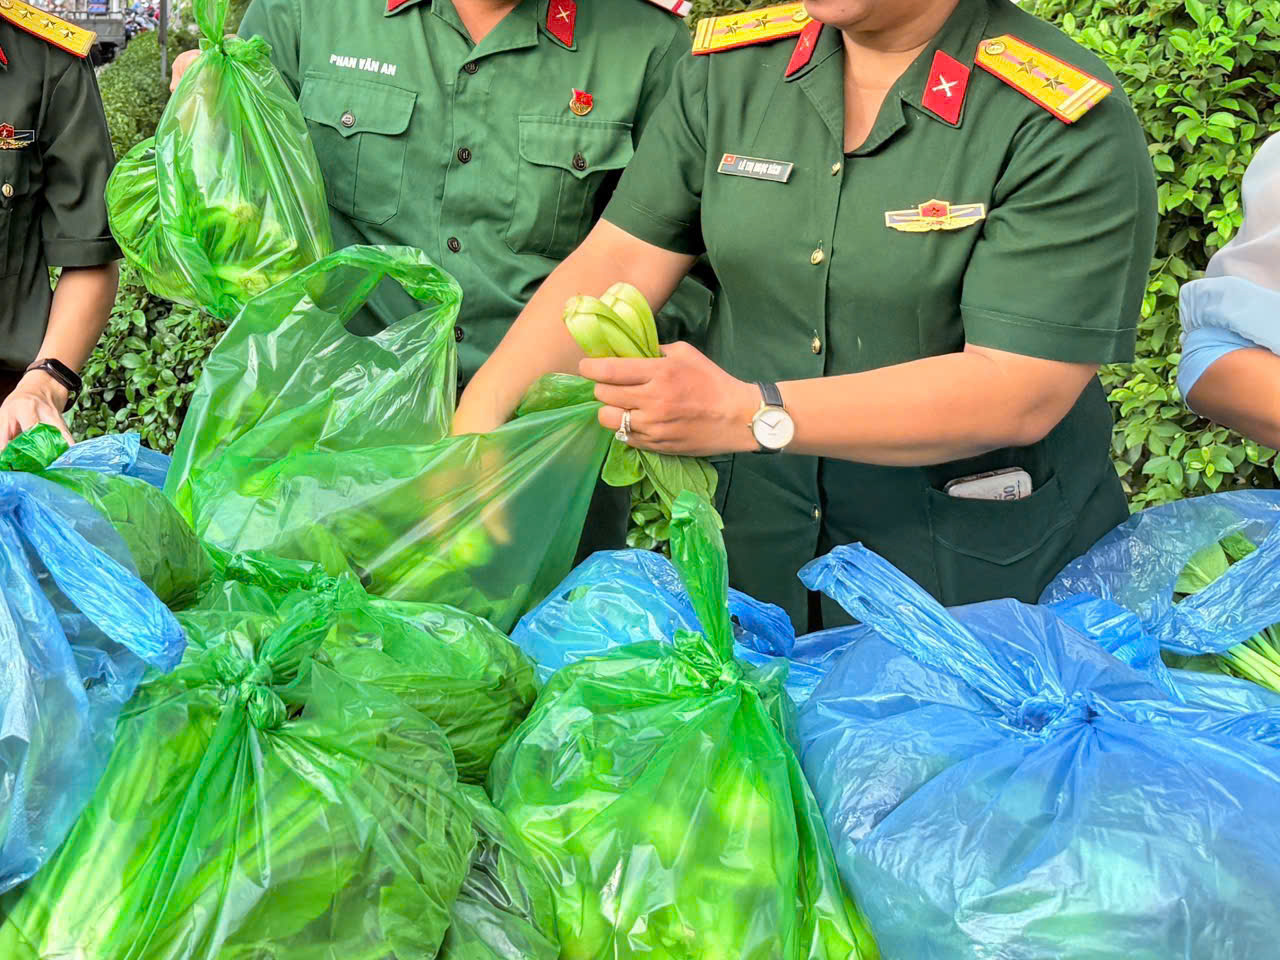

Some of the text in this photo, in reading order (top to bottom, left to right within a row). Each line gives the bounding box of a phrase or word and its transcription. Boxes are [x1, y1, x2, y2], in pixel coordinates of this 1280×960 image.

[329, 53, 397, 77] PHAN VĂN AN
